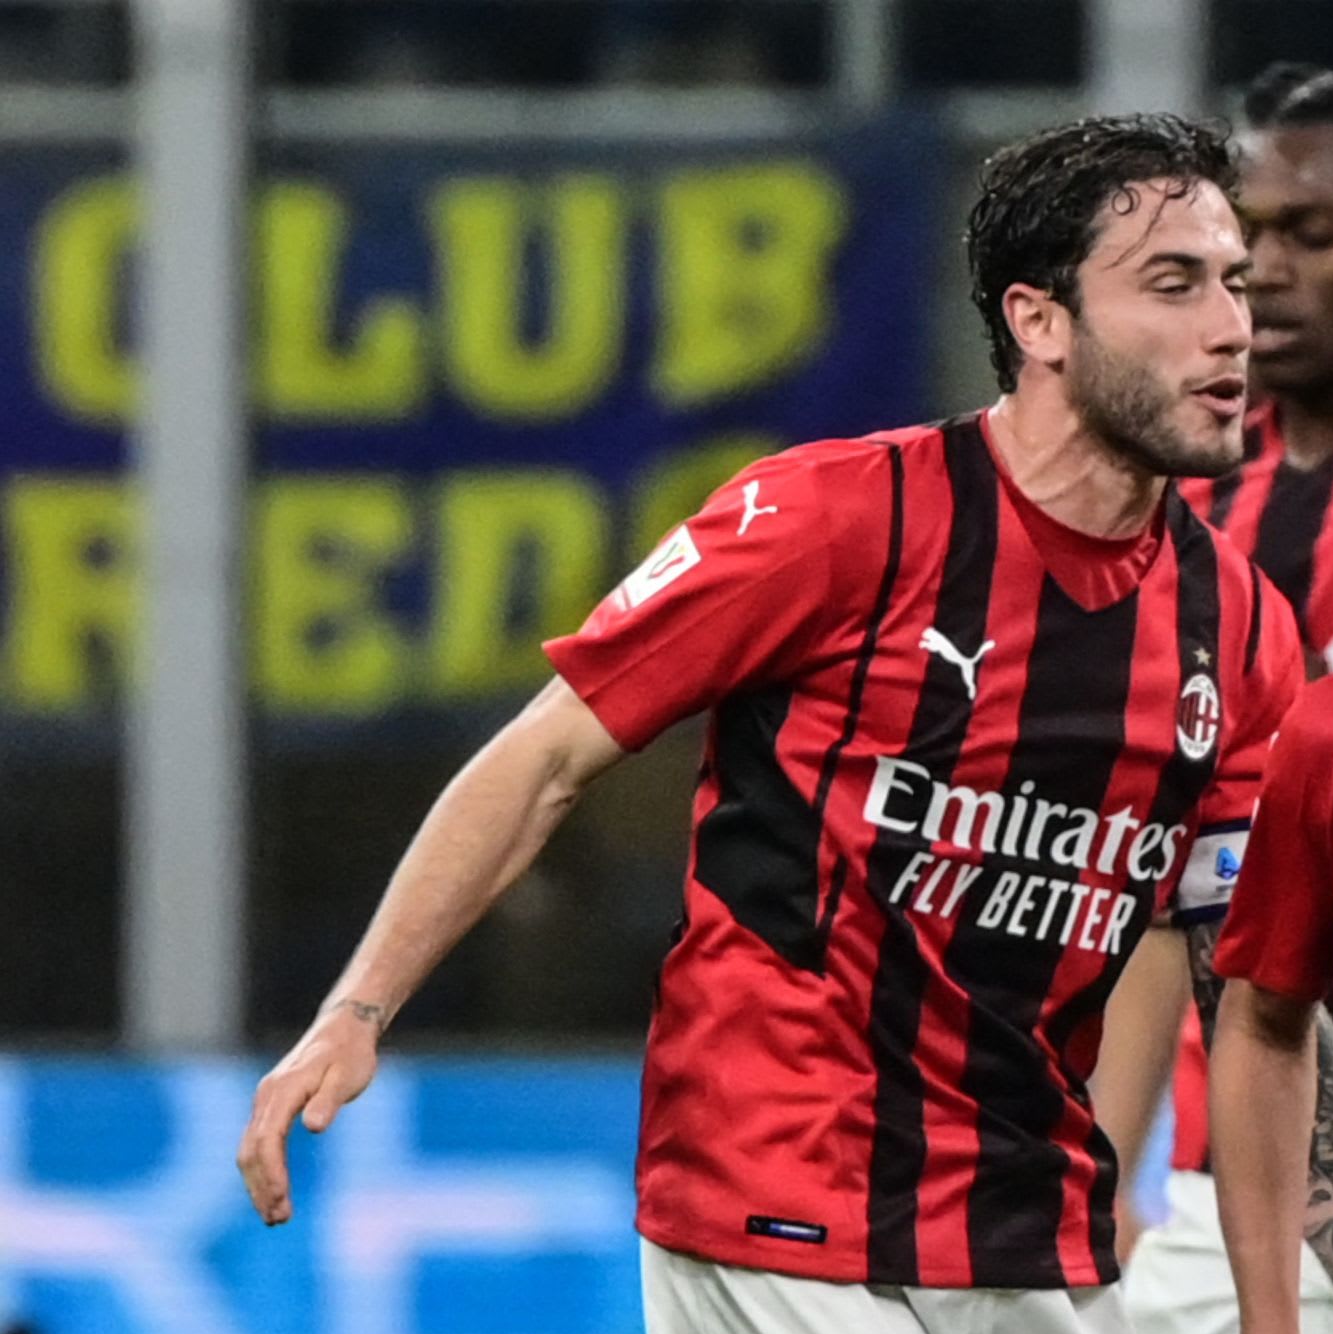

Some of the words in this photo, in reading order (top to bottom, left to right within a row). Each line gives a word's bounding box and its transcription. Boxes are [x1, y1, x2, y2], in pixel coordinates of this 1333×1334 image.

[33, 160, 848, 426] CLUB
[863, 755, 1187, 882] Emirates
[889, 851, 983, 919] FLY
[977, 871, 1137, 956] BETTER
